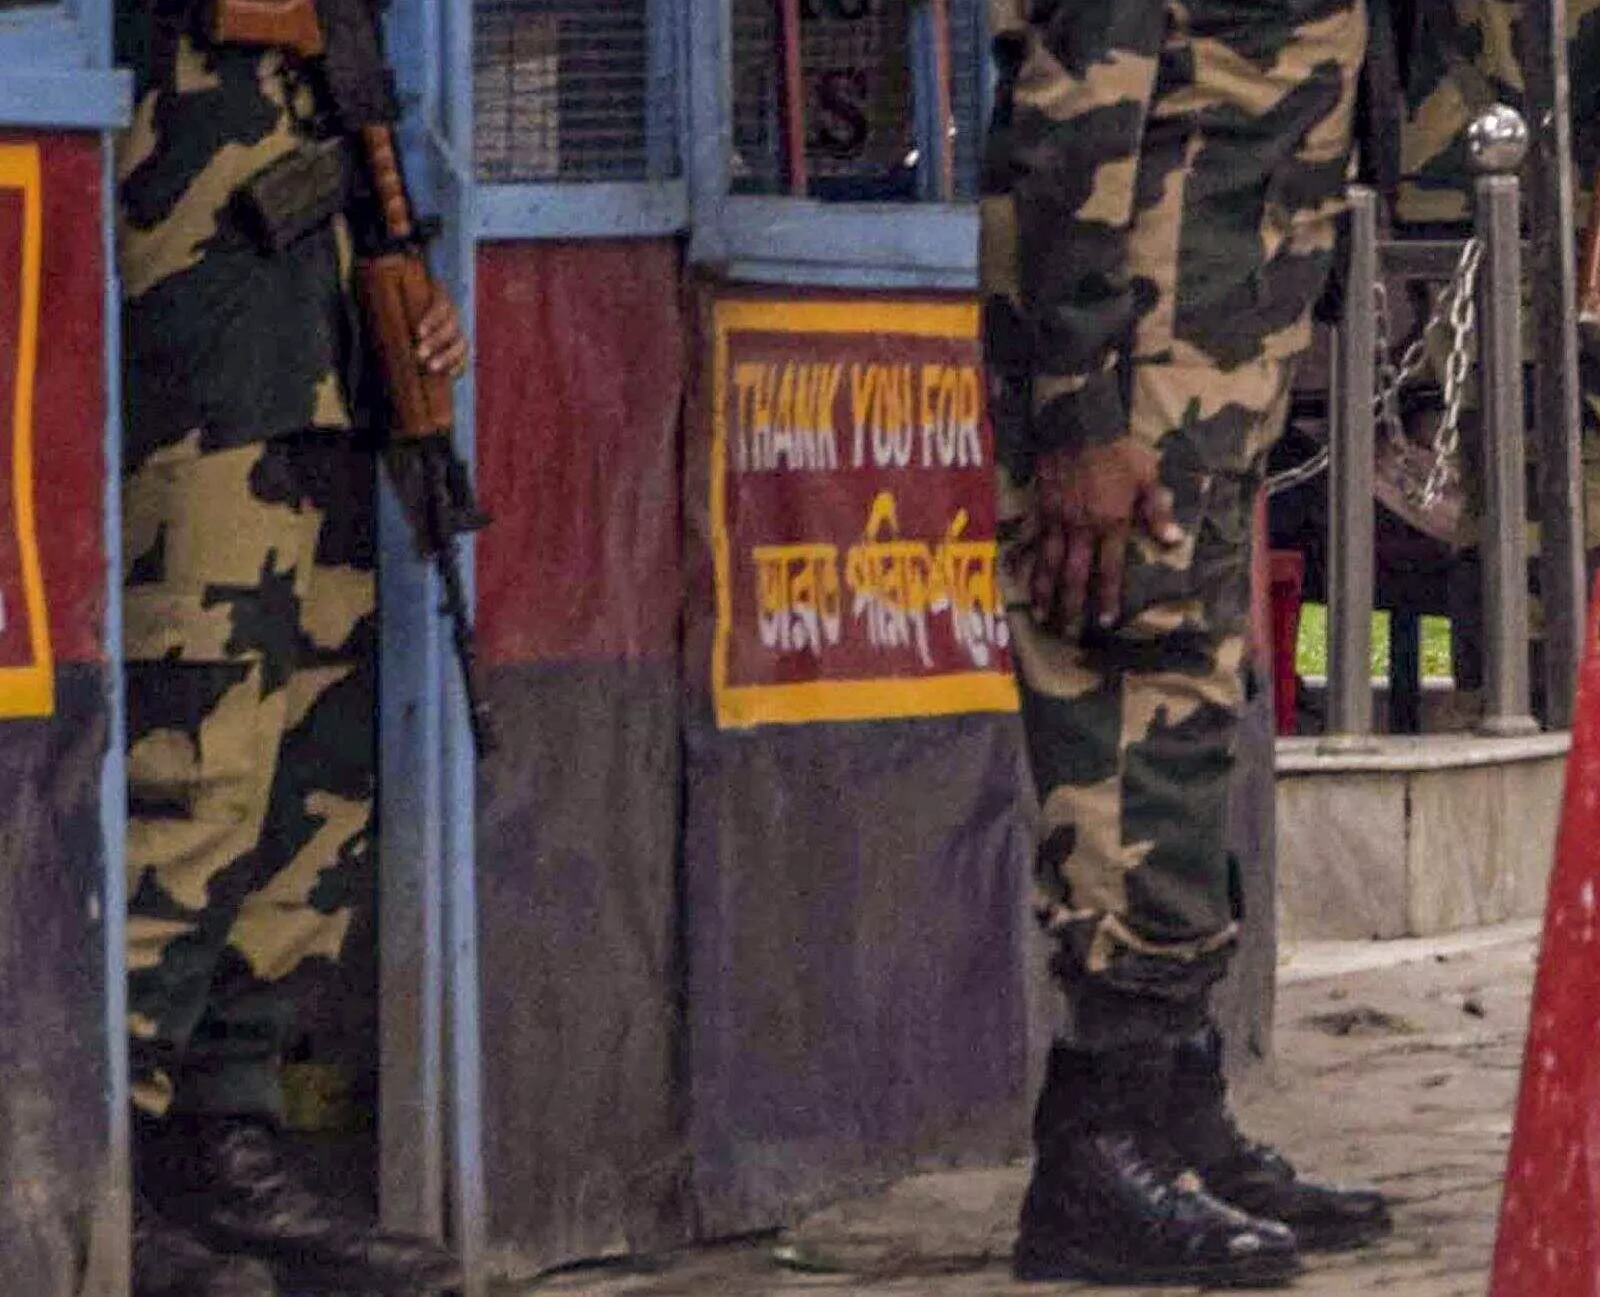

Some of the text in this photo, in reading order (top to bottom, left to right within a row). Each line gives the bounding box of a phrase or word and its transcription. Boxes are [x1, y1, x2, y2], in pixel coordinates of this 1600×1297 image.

[734, 360, 983, 472] THANK YOU FOR
